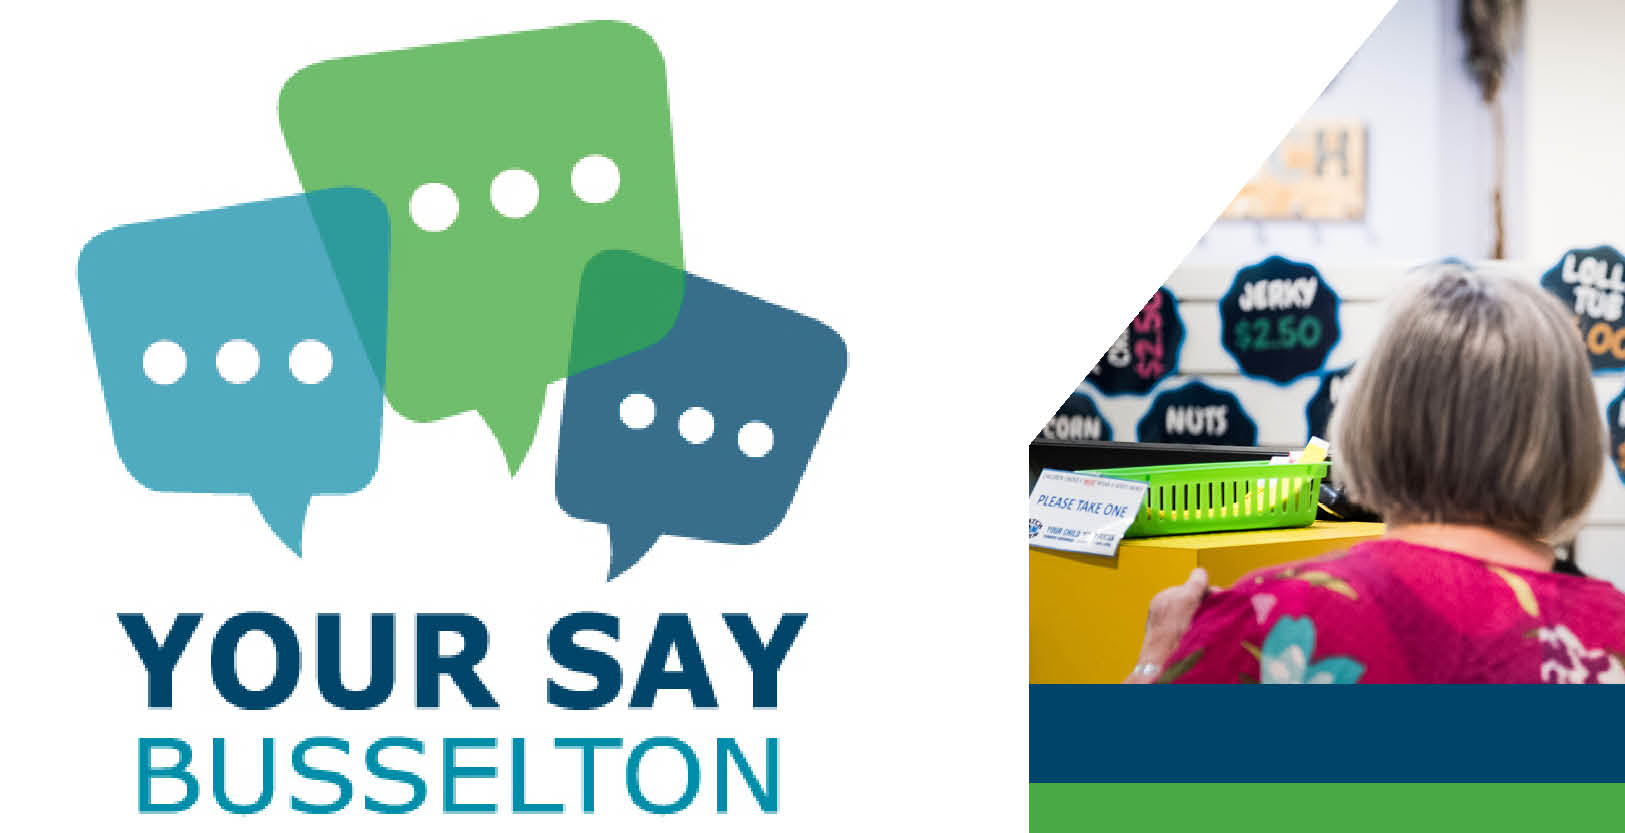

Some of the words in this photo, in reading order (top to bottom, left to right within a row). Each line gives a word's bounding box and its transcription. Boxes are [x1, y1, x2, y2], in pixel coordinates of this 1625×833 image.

[1239, 277, 1318, 312] JERKY
[1235, 316, 1321, 350] $2.50
[1165, 405, 1228, 437] NUTS
[1037, 494, 1075, 511] PLEASE
[1075, 499, 1102, 515] TAKE
[1104, 503, 1128, 518] ONE
